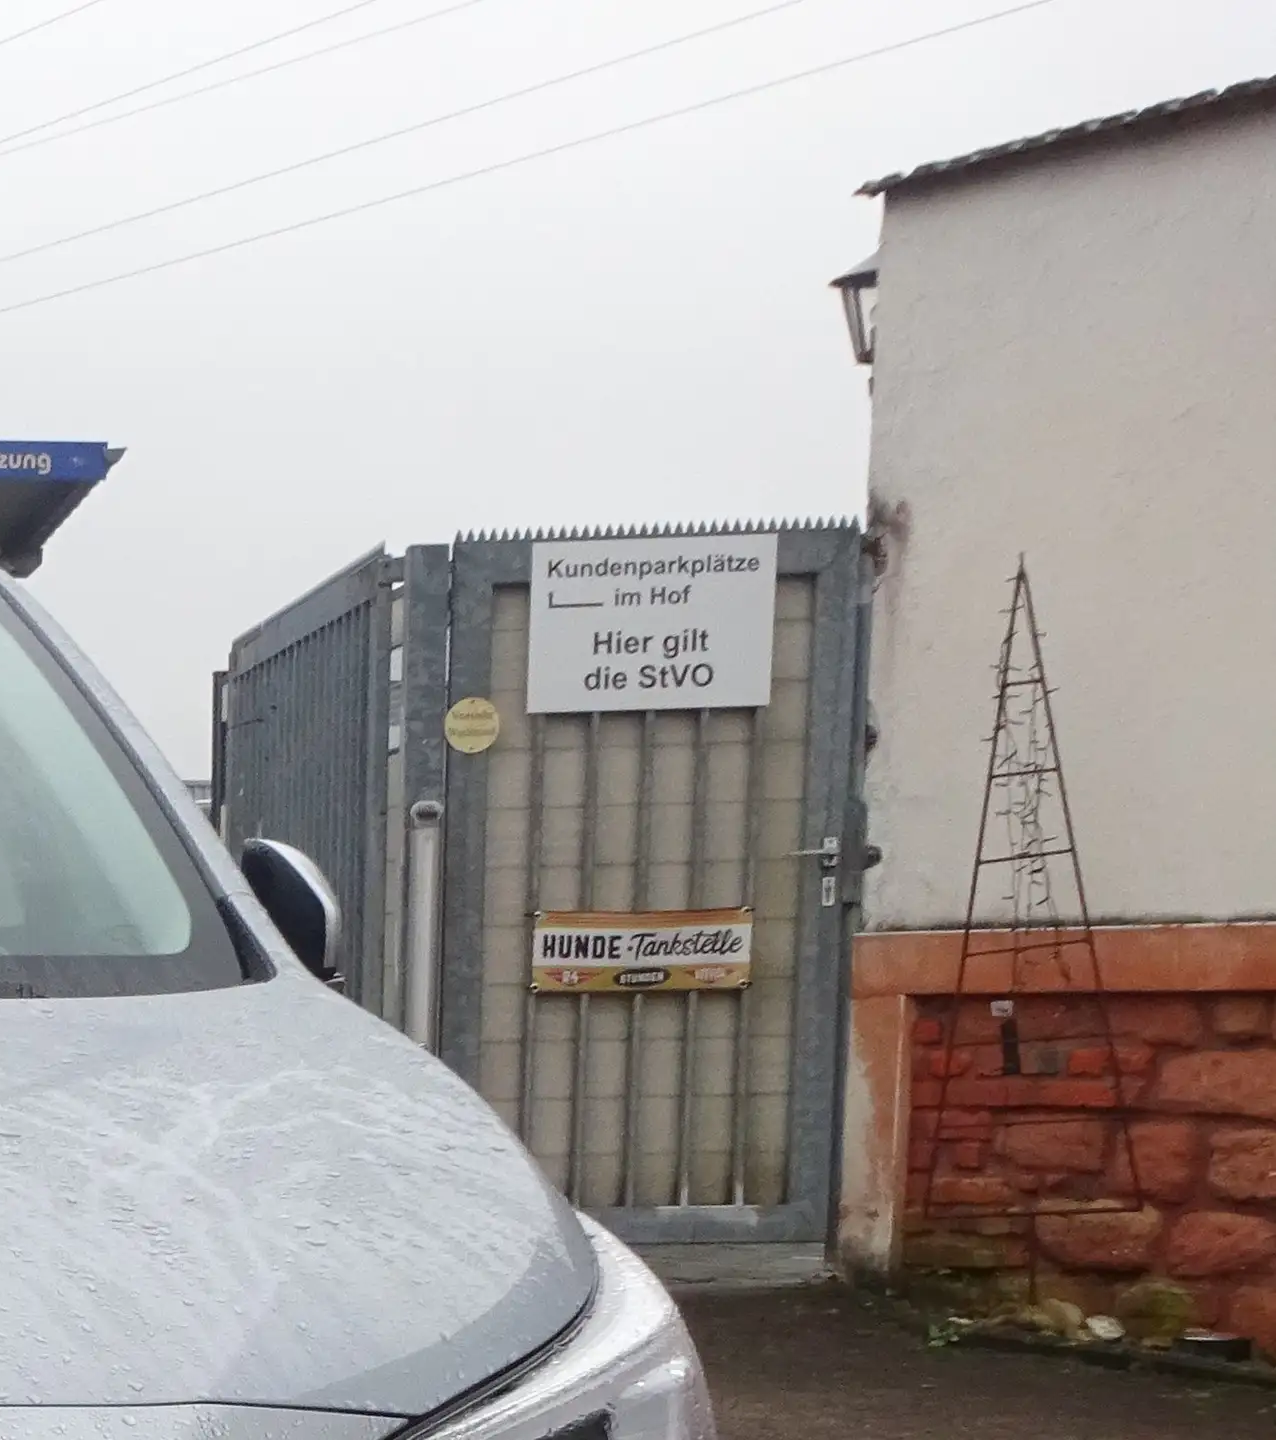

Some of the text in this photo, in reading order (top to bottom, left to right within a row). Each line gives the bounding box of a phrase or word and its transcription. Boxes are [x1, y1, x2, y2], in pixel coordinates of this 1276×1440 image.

[548, 553, 760, 580] Kundenparkplätze
[614, 585, 692, 606] im Hof
[593, 628, 710, 660] Hier gilt
[584, 663, 715, 691] die StVO
[542, 933, 622, 959] HUNDE
